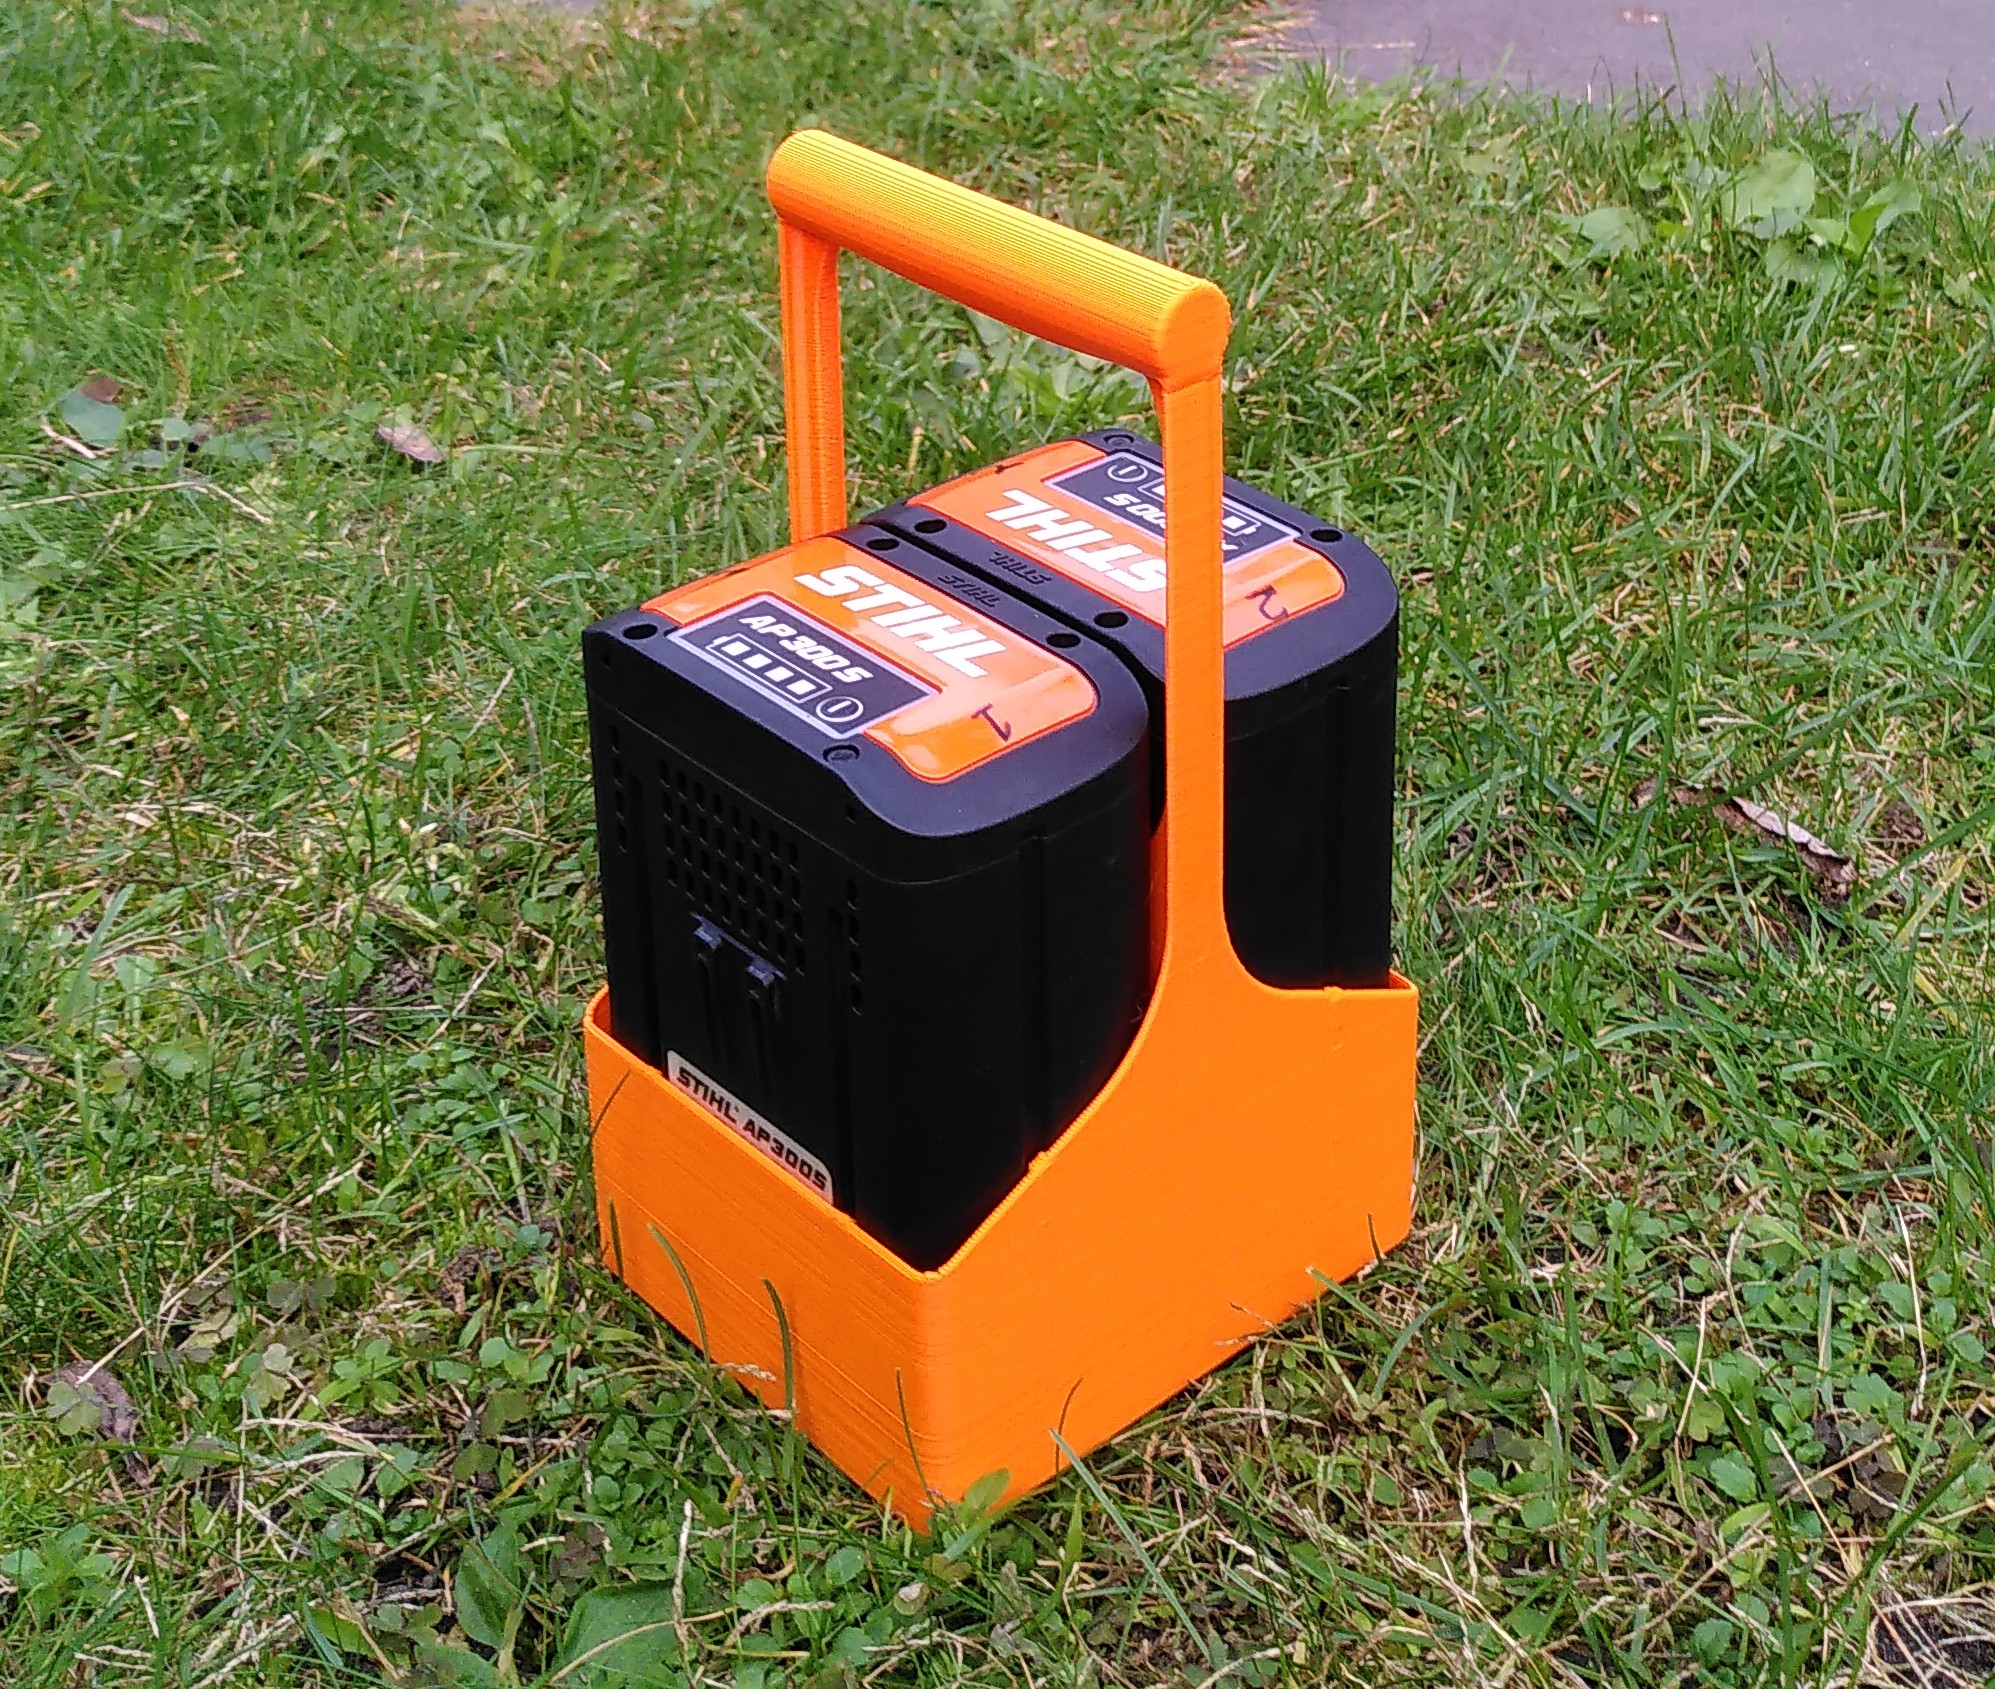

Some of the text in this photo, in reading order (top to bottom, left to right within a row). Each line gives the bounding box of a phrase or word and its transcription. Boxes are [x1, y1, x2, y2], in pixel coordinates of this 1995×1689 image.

[937, 574, 1000, 608] STIHL
[989, 551, 1052, 585] STIHL
[740, 615, 874, 683] AP300S
[794, 565, 1006, 678] STIHL
[676, 1066, 827, 1190] STIHL AP300S
